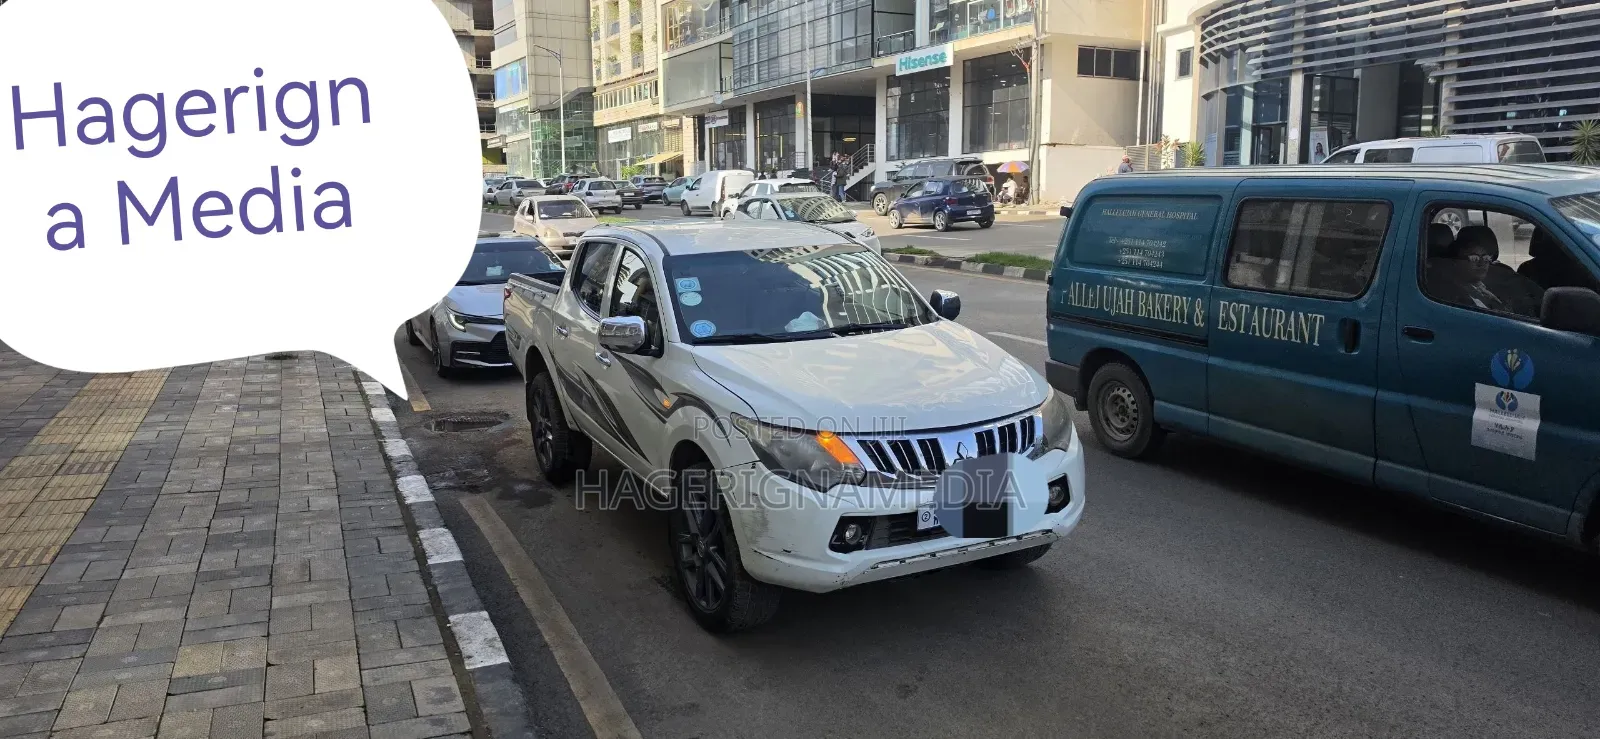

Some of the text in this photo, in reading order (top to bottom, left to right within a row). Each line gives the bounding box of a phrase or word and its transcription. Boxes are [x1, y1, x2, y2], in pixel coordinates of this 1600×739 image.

[899, 52, 947, 71] Hisense
[1137, 210, 1165, 219] GENERAL
[1166, 211, 1198, 220] HOSPITAL
[1137, 290, 1191, 325] BAKERY
[1194, 298, 1204, 328] &
